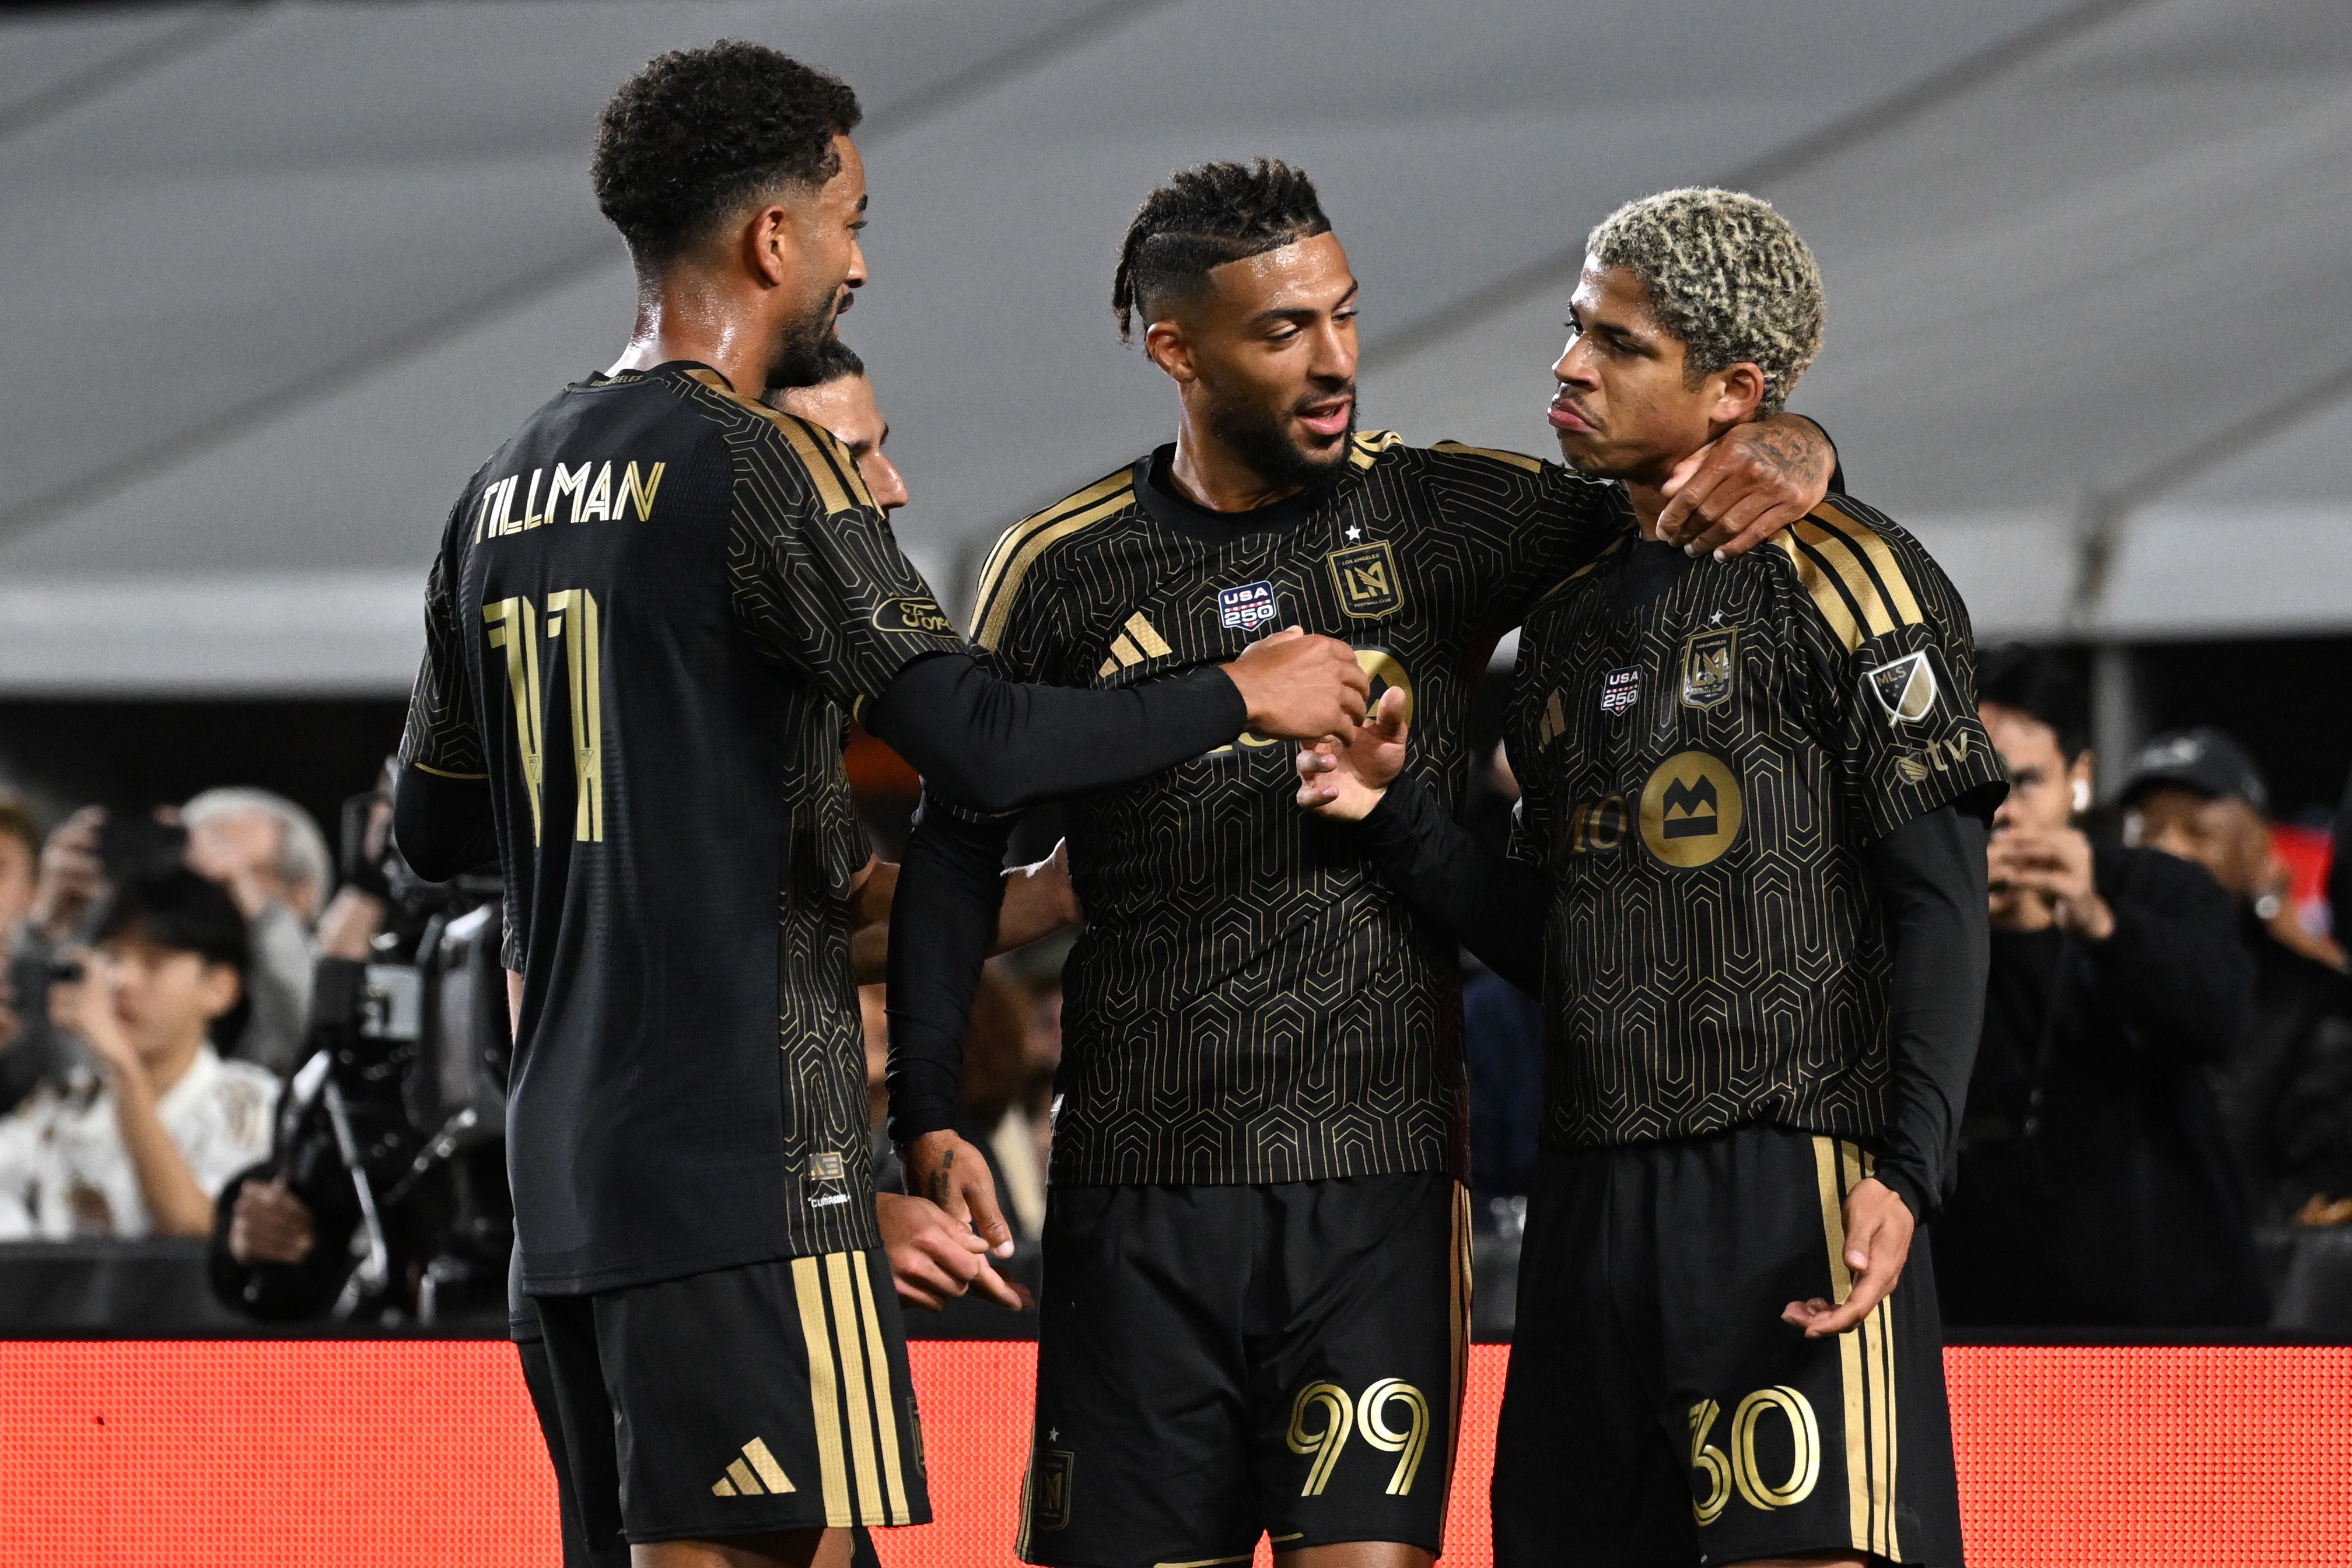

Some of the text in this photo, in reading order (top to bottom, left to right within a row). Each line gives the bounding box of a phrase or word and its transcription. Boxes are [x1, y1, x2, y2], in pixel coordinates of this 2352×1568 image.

[475, 460, 666, 544] TILLMAN
[1354, 554, 1380, 562] ANGELES
[1224, 587, 1269, 604] USA
[1224, 604, 1273, 625] 250
[1609, 671, 1638, 685] USA
[1875, 666, 1906, 687] MLS
[1603, 690, 1637, 708] 250
[482, 589, 603, 848] 11
[1926, 732, 1968, 771] tv
[1286, 1378, 1429, 1497] 99
[1689, 1385, 1820, 1527] 30
